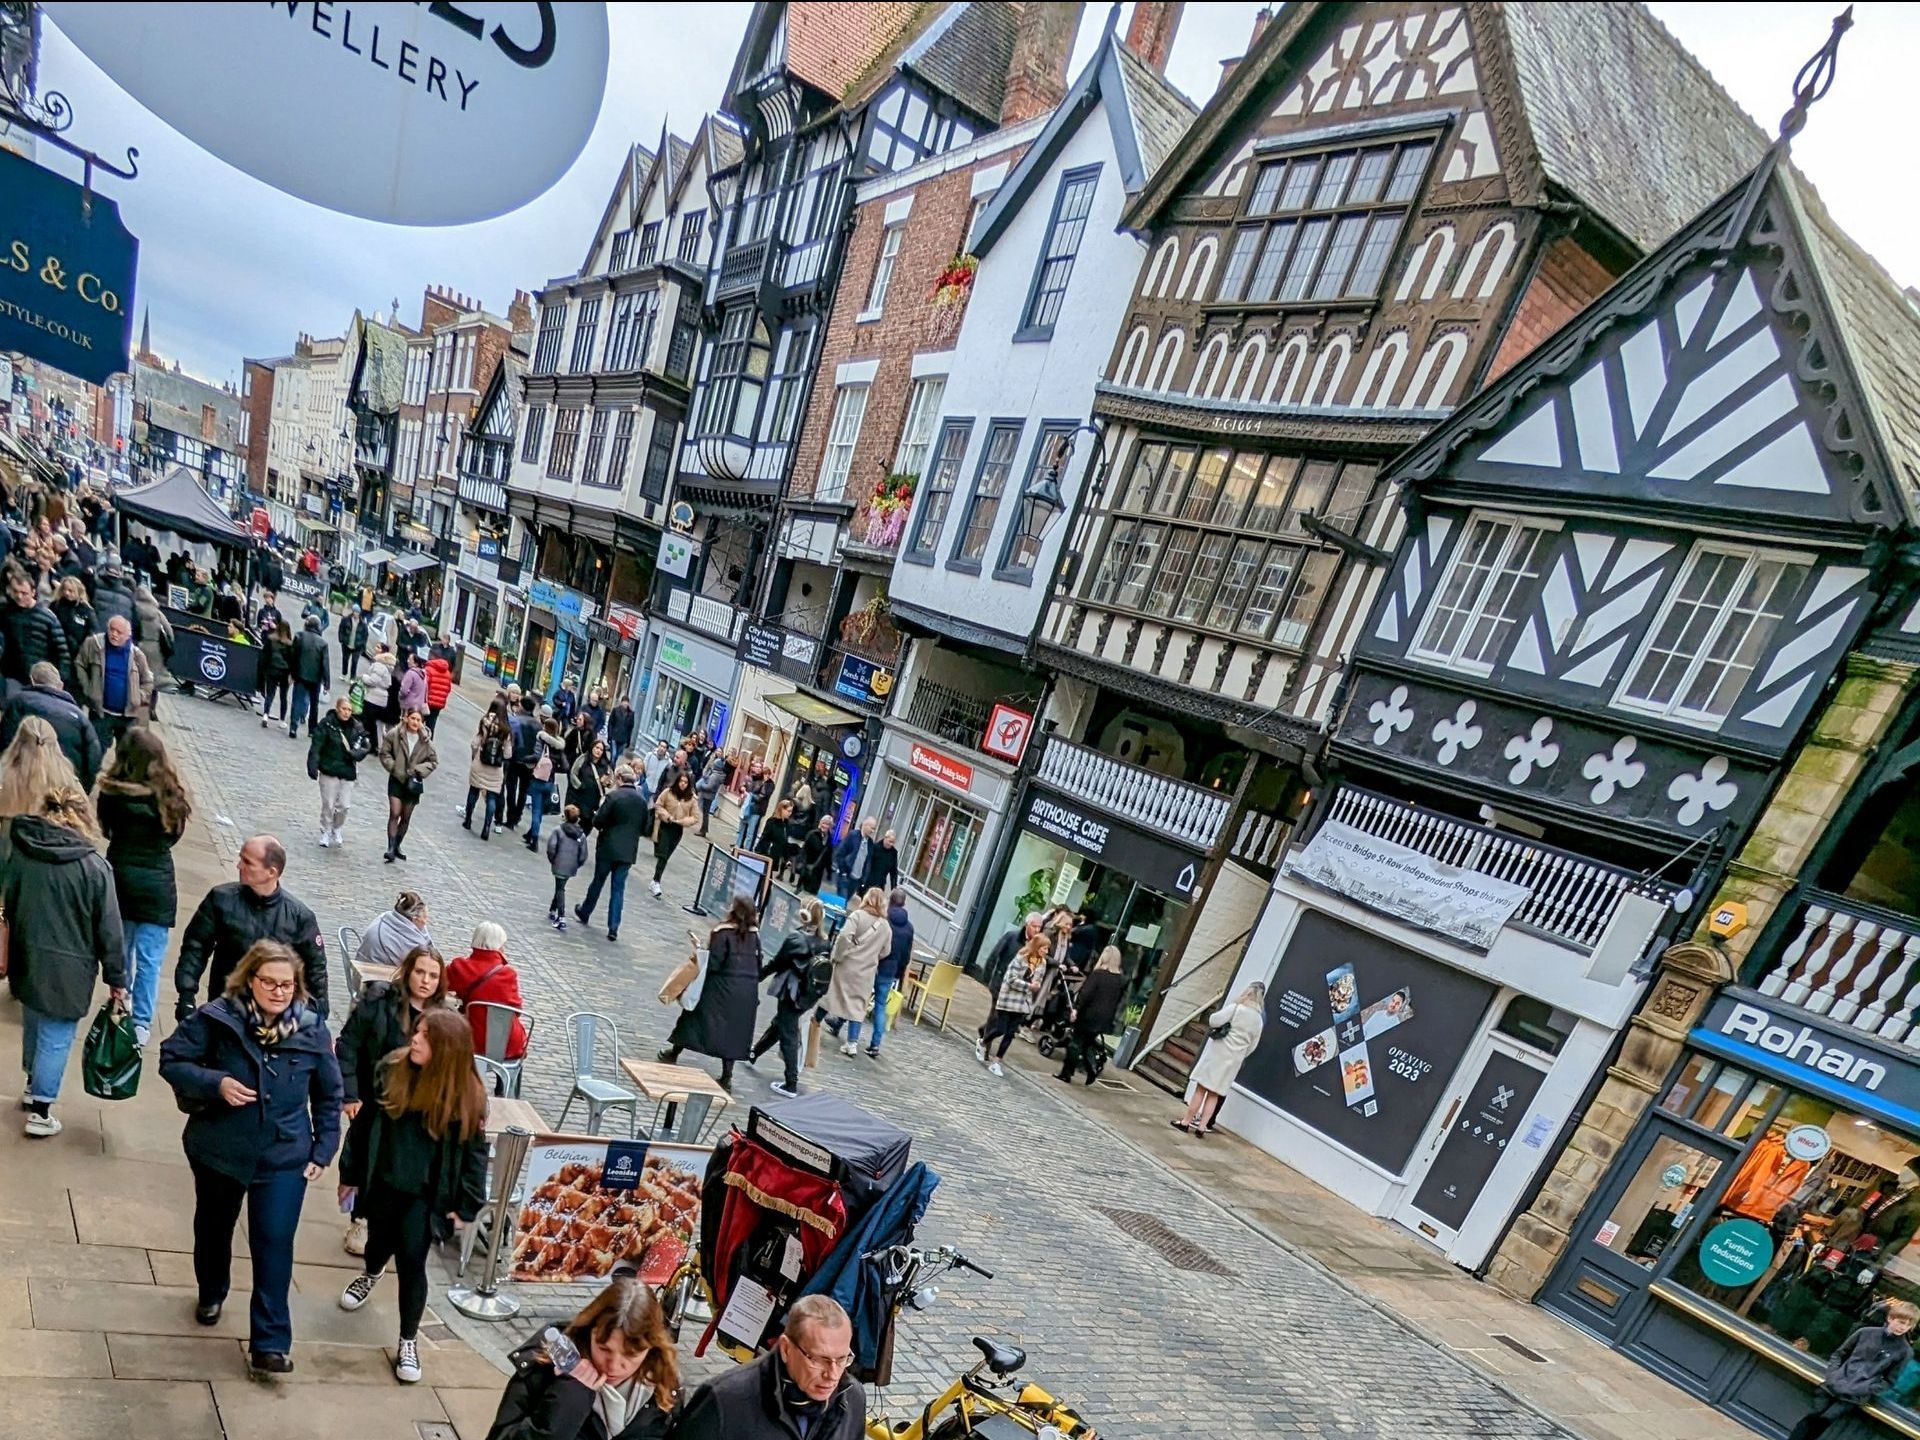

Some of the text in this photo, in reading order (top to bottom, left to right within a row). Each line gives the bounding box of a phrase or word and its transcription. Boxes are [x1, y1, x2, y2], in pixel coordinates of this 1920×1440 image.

[0, 241, 124, 317] S & Co.
[744, 632, 780, 651] & Vape Hut
[748, 625, 780, 642] City News
[919, 753, 943, 775] Principality
[1031, 798, 1110, 844] ARTHOUSE CAFE
[1321, 832, 1346, 847] Access
[1344, 842, 1352, 850] to
[1352, 844, 1376, 862] Bridge
[1376, 853, 1386, 864] St
[1386, 857, 1402, 871] Row
[1453, 882, 1479, 897] Shops
[1479, 891, 1495, 902] this
[1495, 898, 1514, 908] way
[1721, 1002, 1887, 1091] Rohan
[1388, 1046, 1433, 1073] OPENING
[1389, 1058, 1420, 1081] 2023
[544, 1149, 591, 1162] Belgian
[607, 1168, 638, 1177] Leonidas
[1709, 1243, 1756, 1271] Reductions
[1723, 1239, 1754, 1258] Further
